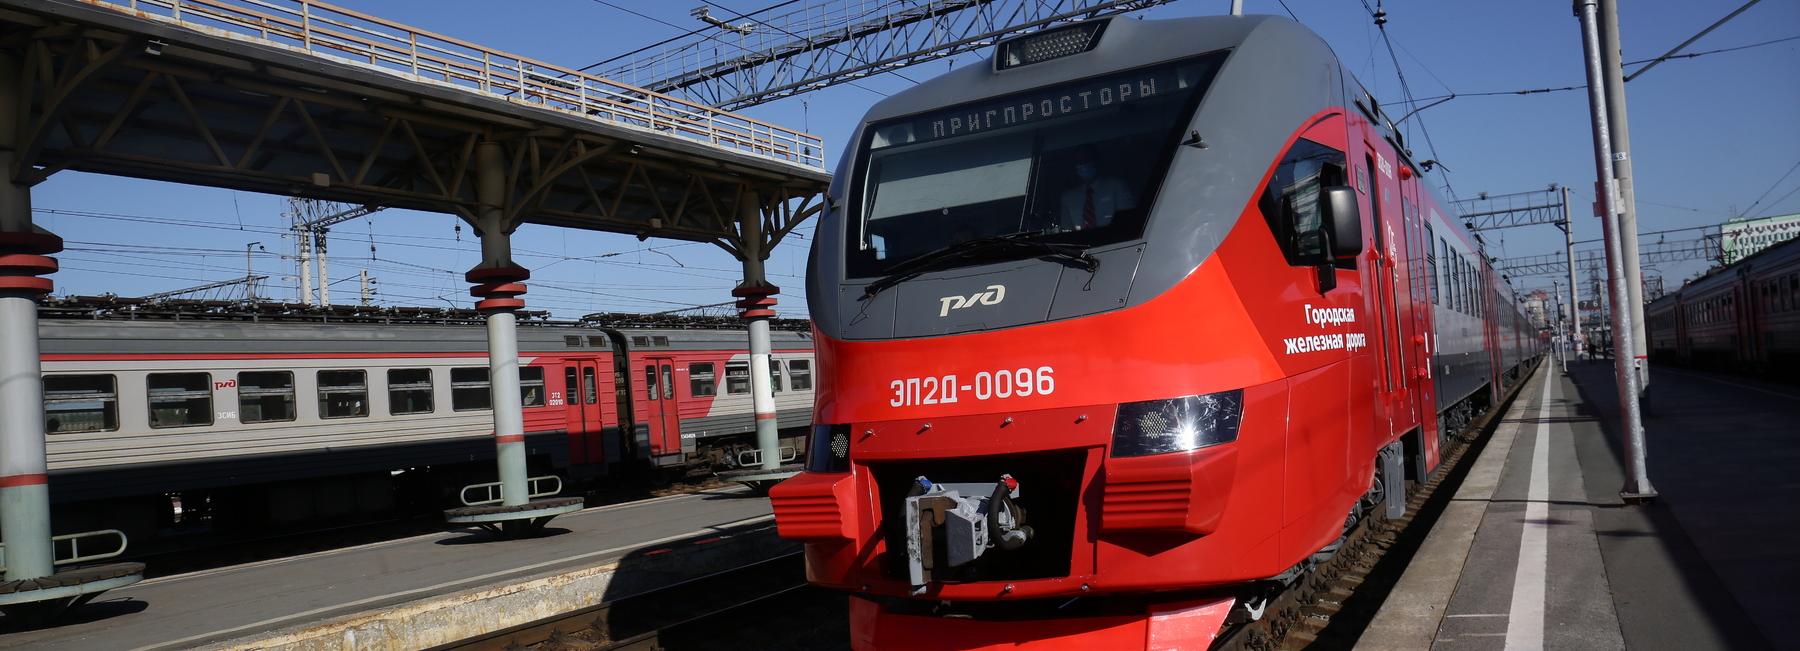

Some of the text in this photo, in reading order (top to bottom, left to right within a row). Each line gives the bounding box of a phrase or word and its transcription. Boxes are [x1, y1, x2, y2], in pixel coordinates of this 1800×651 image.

[933, 78, 1156, 138] ПРИГПРОСТОРЫ
[1304, 304, 1355, 328] Городская
[1283, 333, 1366, 355] железная дорога
[890, 366, 1054, 408] ЭП2Д-0096
